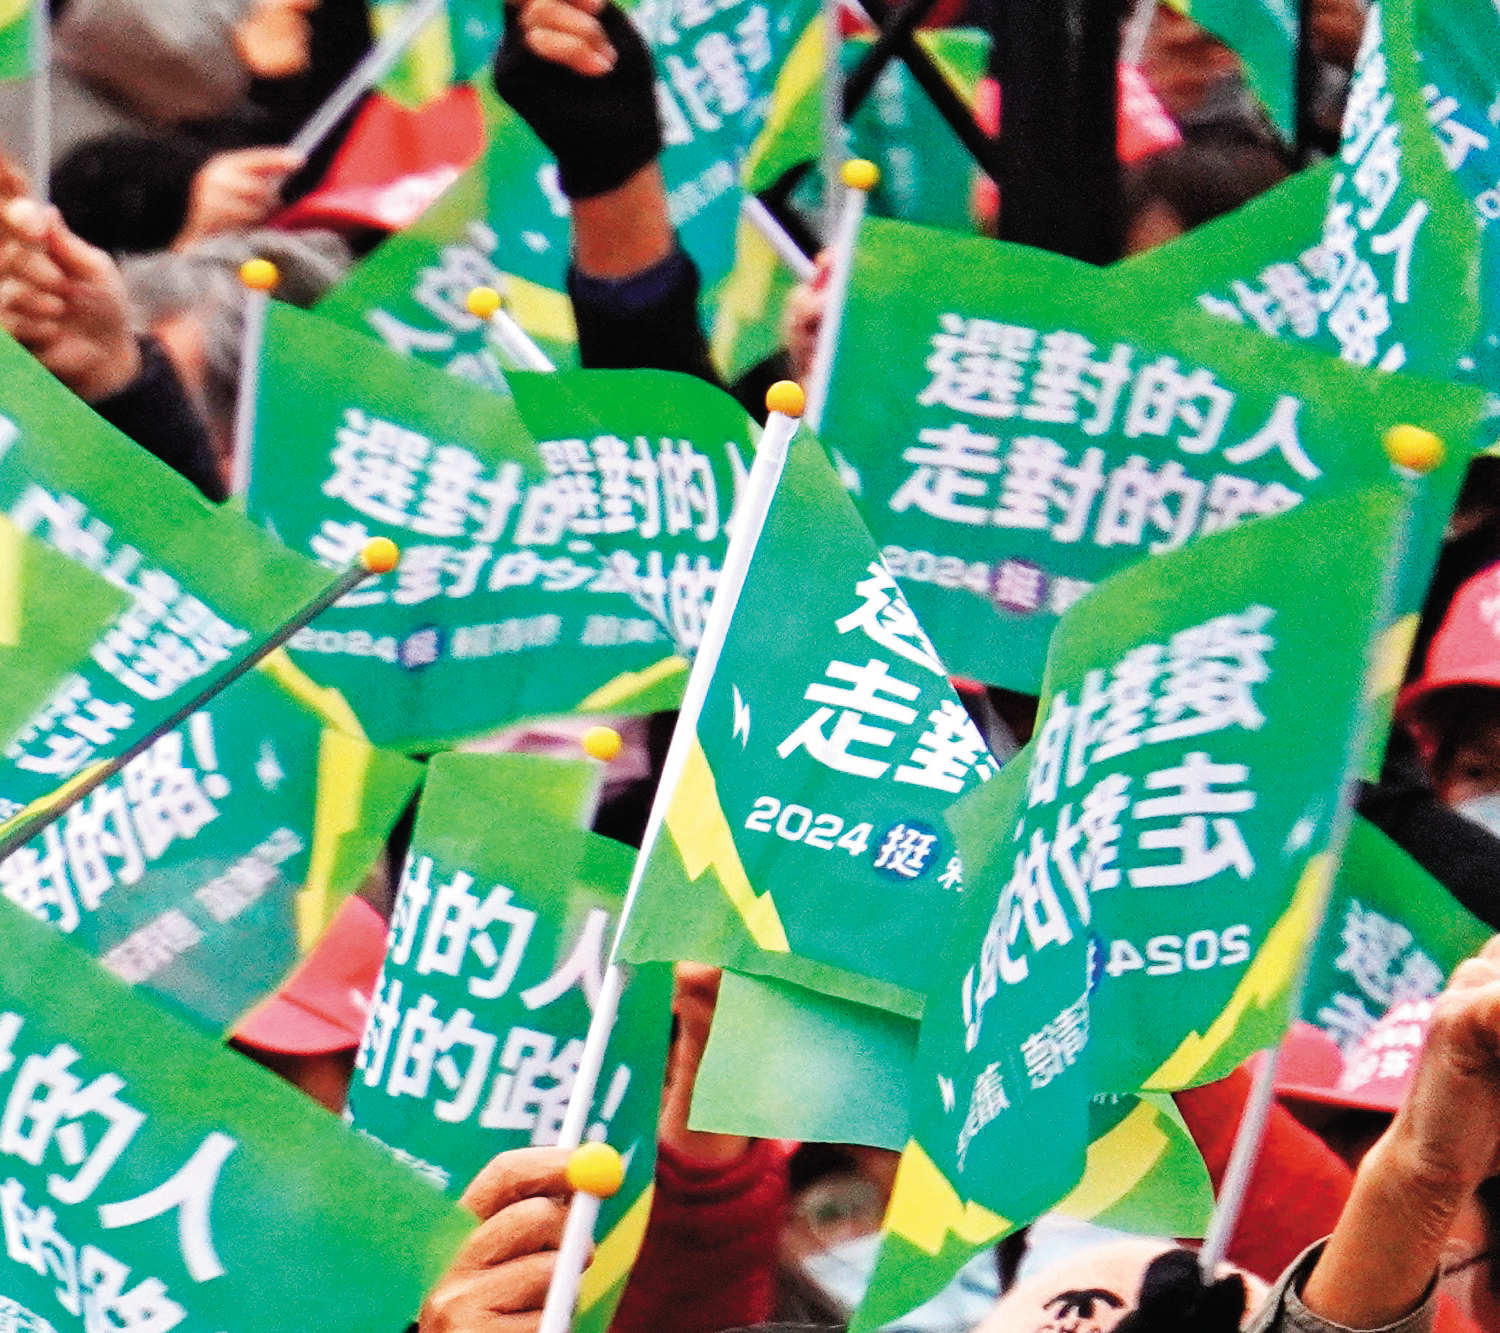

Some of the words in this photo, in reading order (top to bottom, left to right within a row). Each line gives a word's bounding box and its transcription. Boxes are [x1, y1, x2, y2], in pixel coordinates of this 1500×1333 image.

[918, 311, 1326, 482] 選對的人
[743, 795, 873, 859] 2024
[874, 822, 936, 882] 挺
